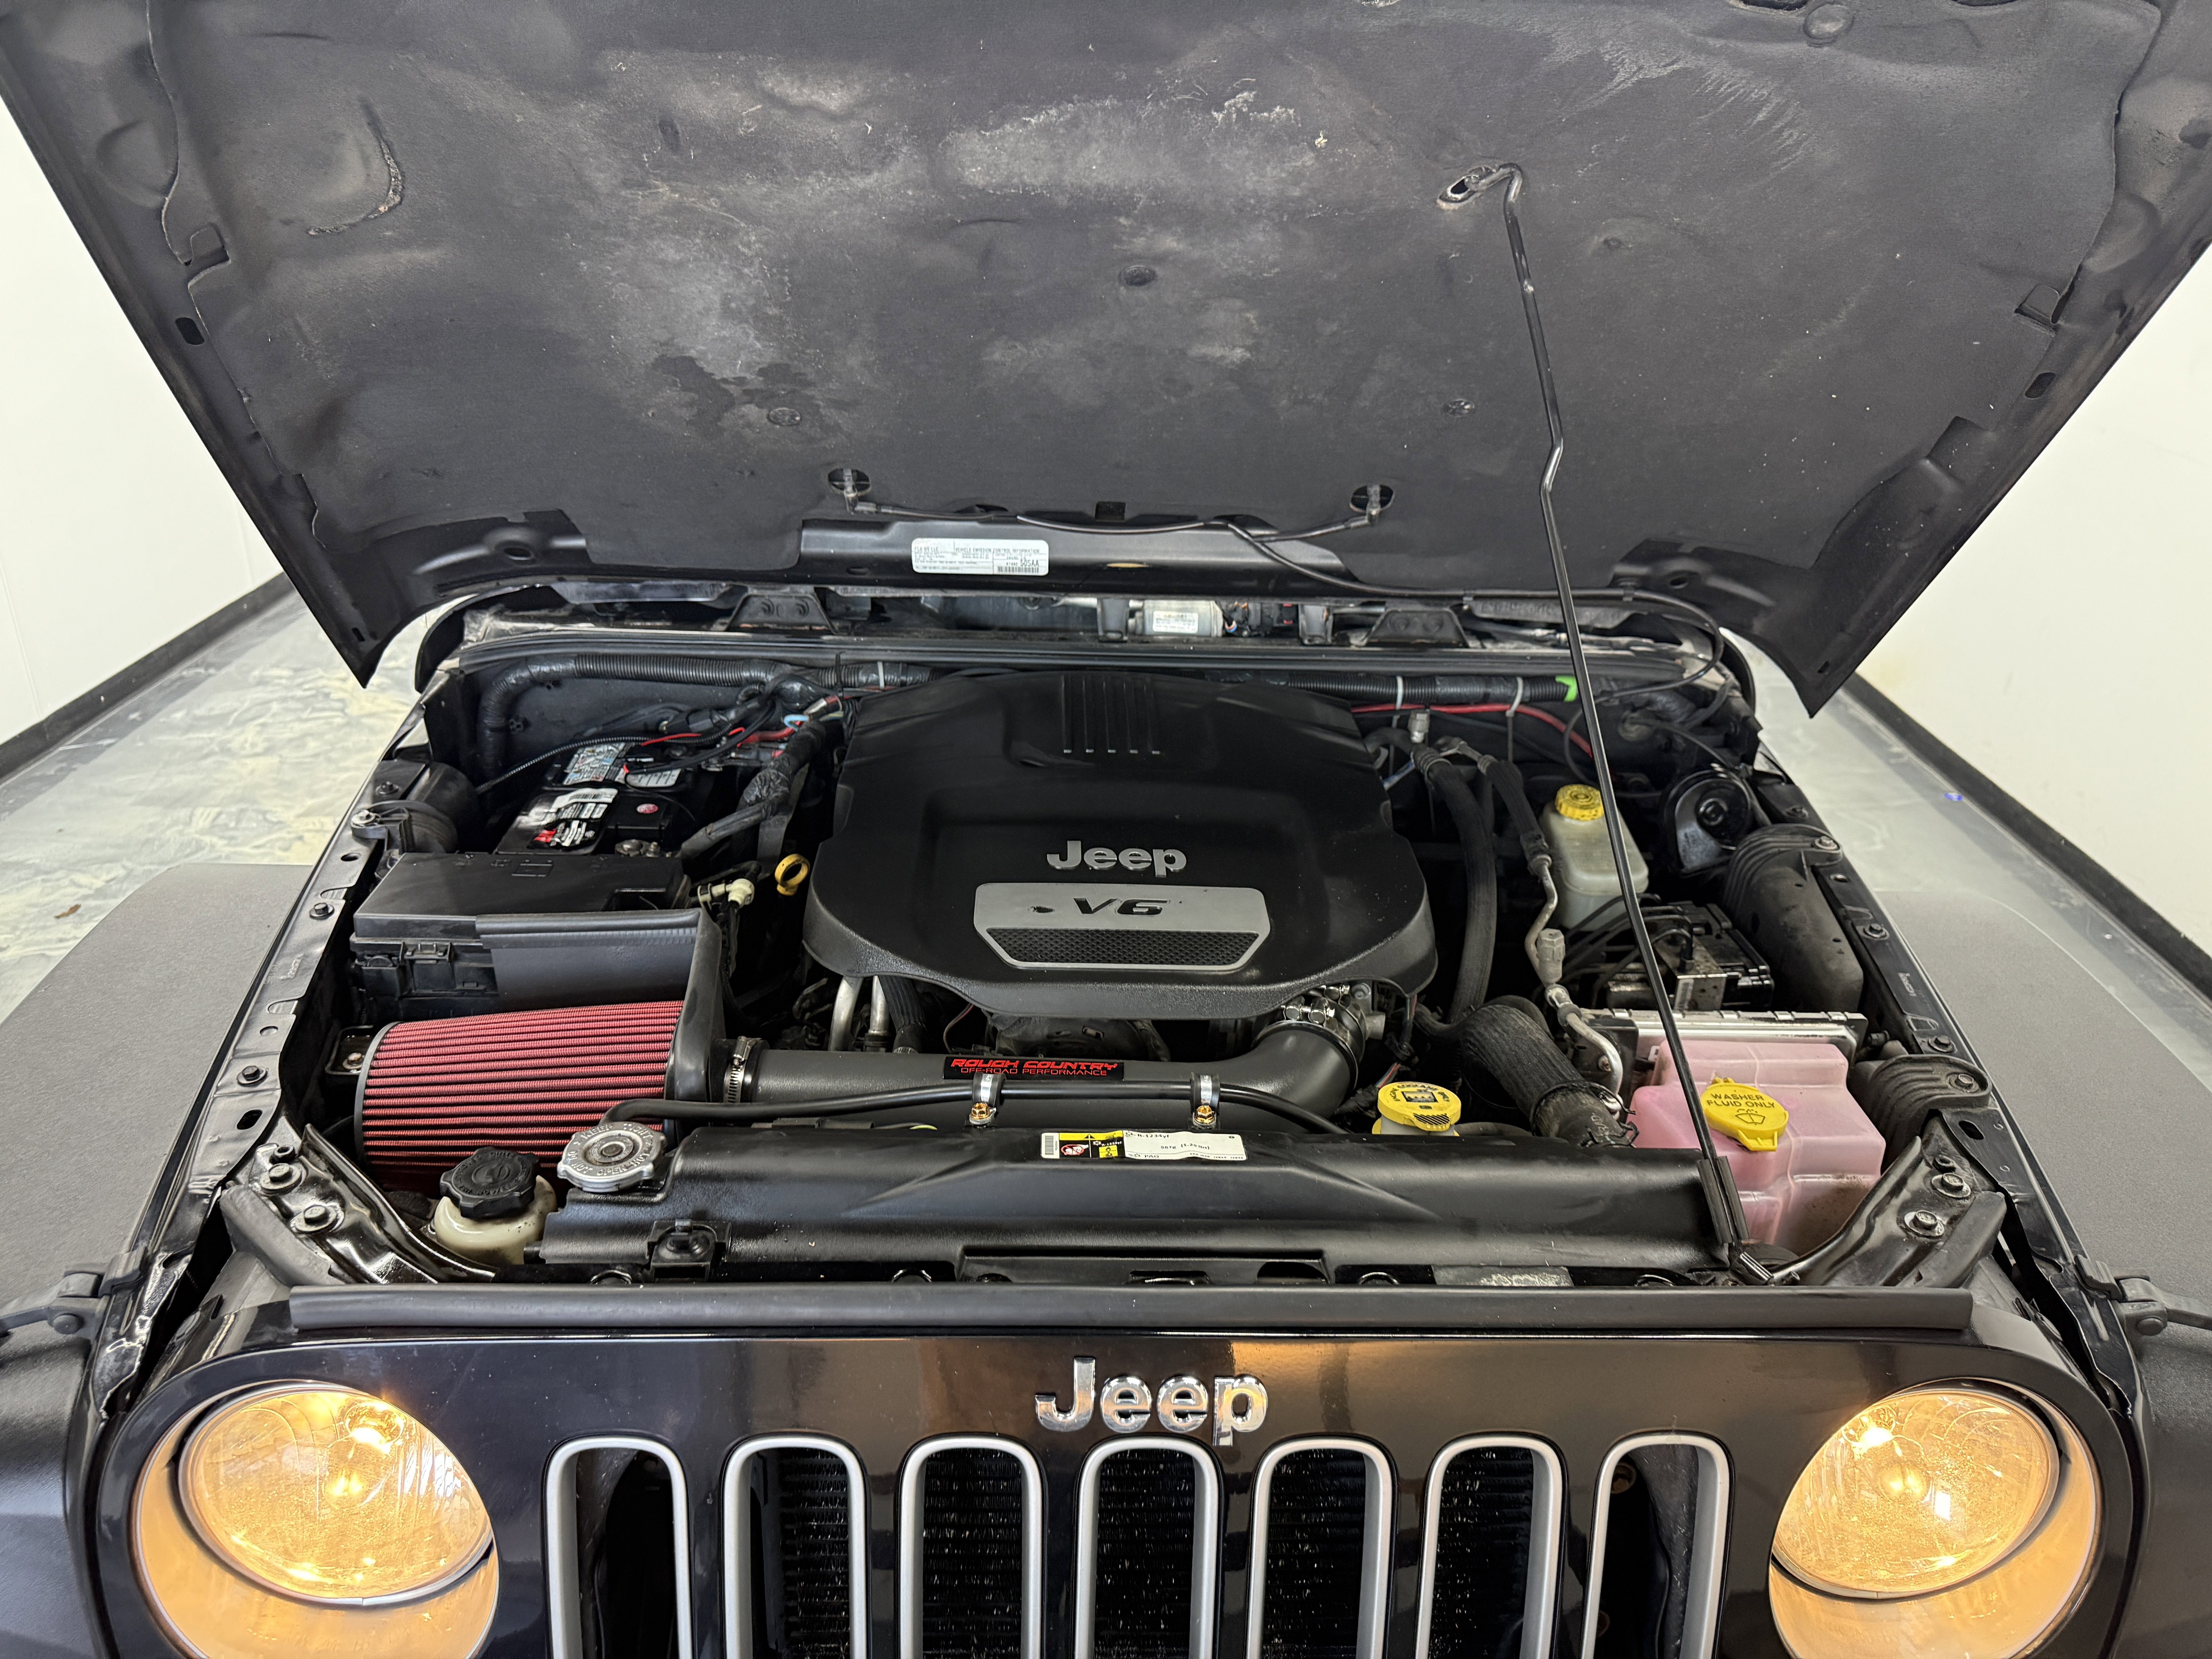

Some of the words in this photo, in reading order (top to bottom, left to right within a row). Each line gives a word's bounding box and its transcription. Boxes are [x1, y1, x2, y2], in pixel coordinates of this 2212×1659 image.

[1047, 840, 1187, 878] Jeep
[1073, 898, 1168, 915] V6
[951, 1059, 1020, 1068] ROUGH
[1024, 1061, 1118, 1070] COUNTRY
[580, 1124, 613, 1139] KEEP
[596, 1165, 628, 1176] OPEN
[1035, 1357, 1268, 1446] Jeep
